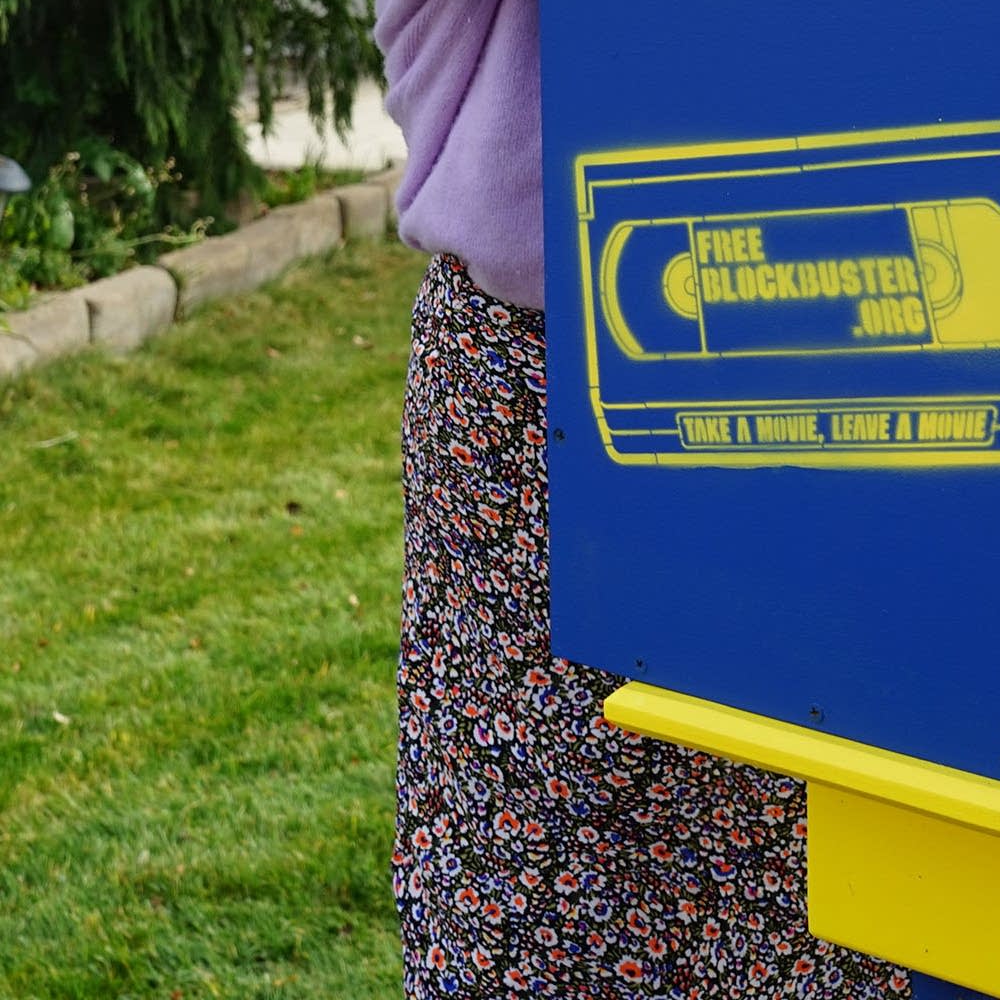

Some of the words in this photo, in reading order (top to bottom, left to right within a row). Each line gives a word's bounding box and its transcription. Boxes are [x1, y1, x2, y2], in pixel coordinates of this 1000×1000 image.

[696, 227, 765, 264] FREE
[701, 256, 919, 303] BLOCKBUSTER
[853, 295, 927, 337] .ORG
[683, 416, 733, 443] TAKE
[737, 415, 751, 443] A
[755, 414, 824, 448] MOVIE,
[831, 412, 890, 441] LEAVE
[896, 411, 912, 440] A
[917, 410, 987, 440] MOVIE
